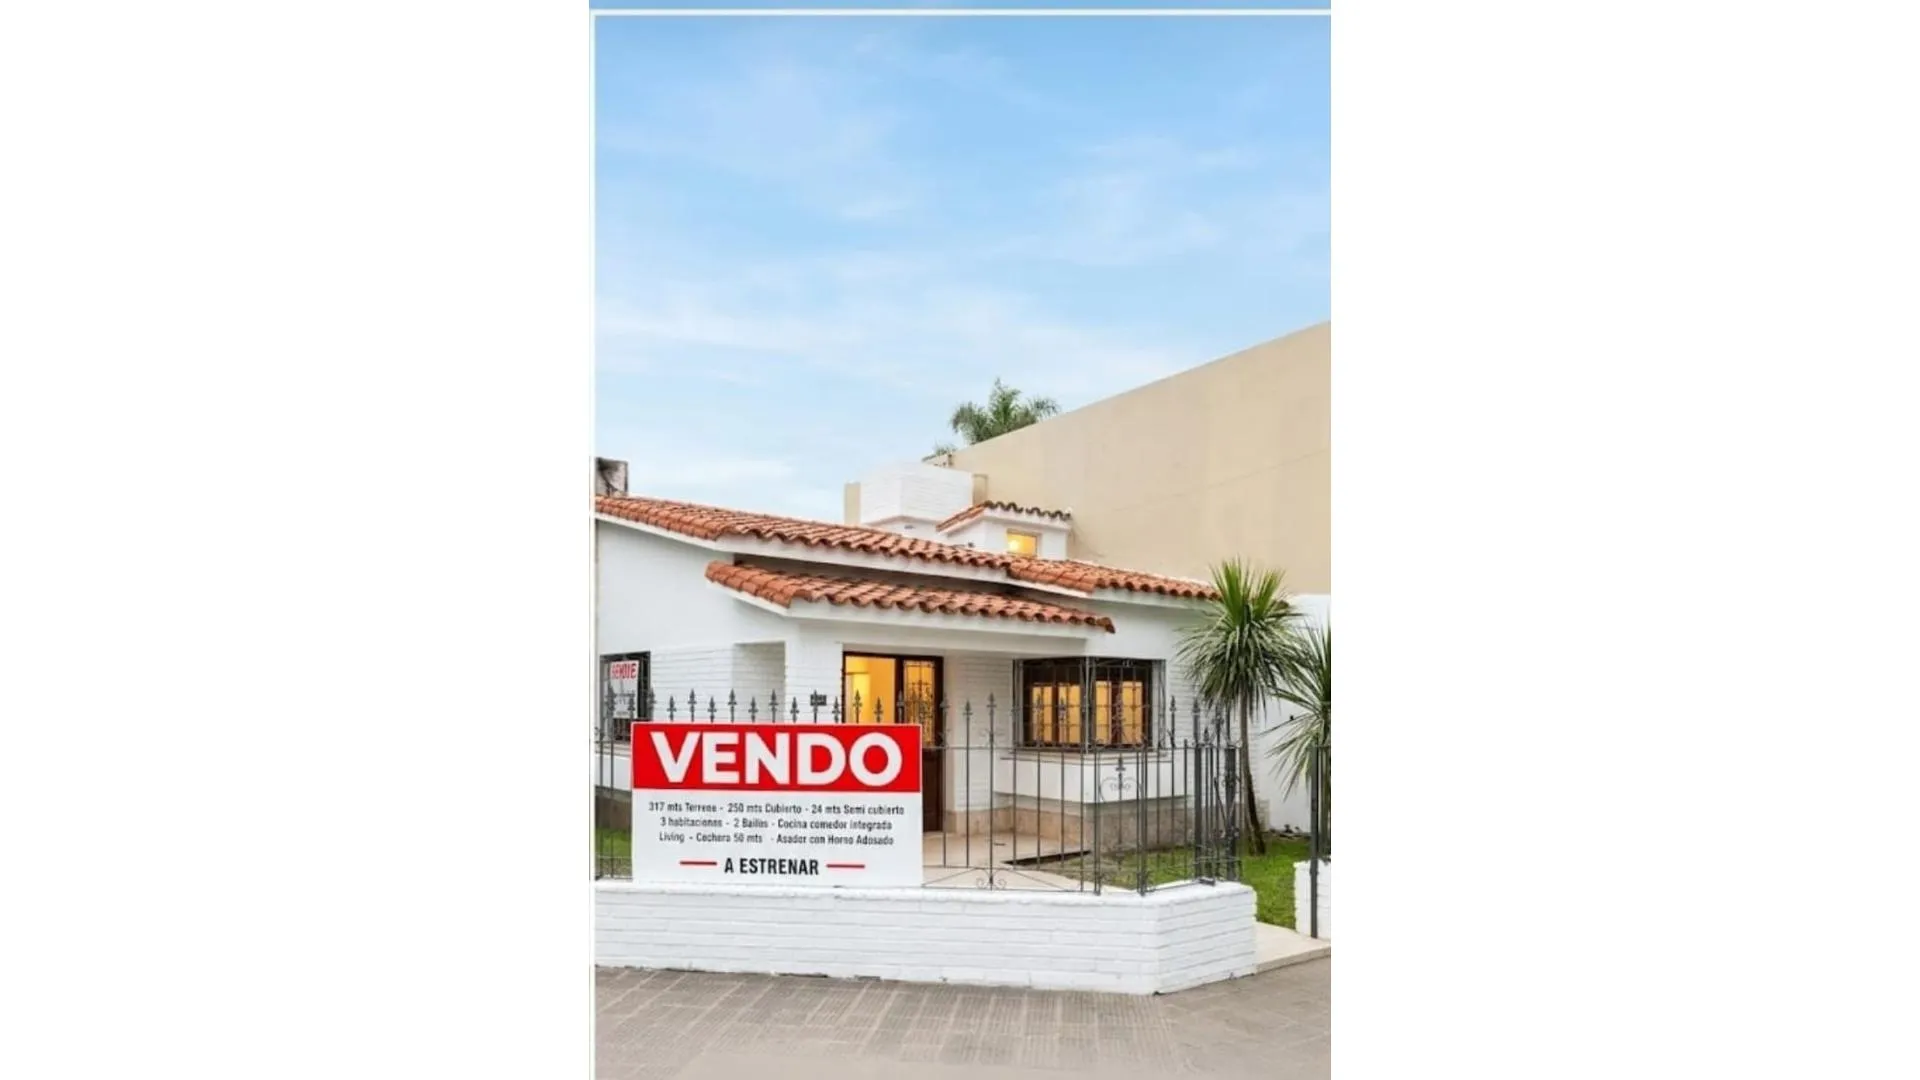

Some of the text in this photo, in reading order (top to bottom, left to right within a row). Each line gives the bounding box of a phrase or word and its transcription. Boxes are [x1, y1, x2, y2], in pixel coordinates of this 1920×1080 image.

[650, 731, 903, 787] VENDO
[649, 802, 664, 812] 317
[728, 804, 744, 813] 250
[724, 858, 819, 875] A ESTRENAR
